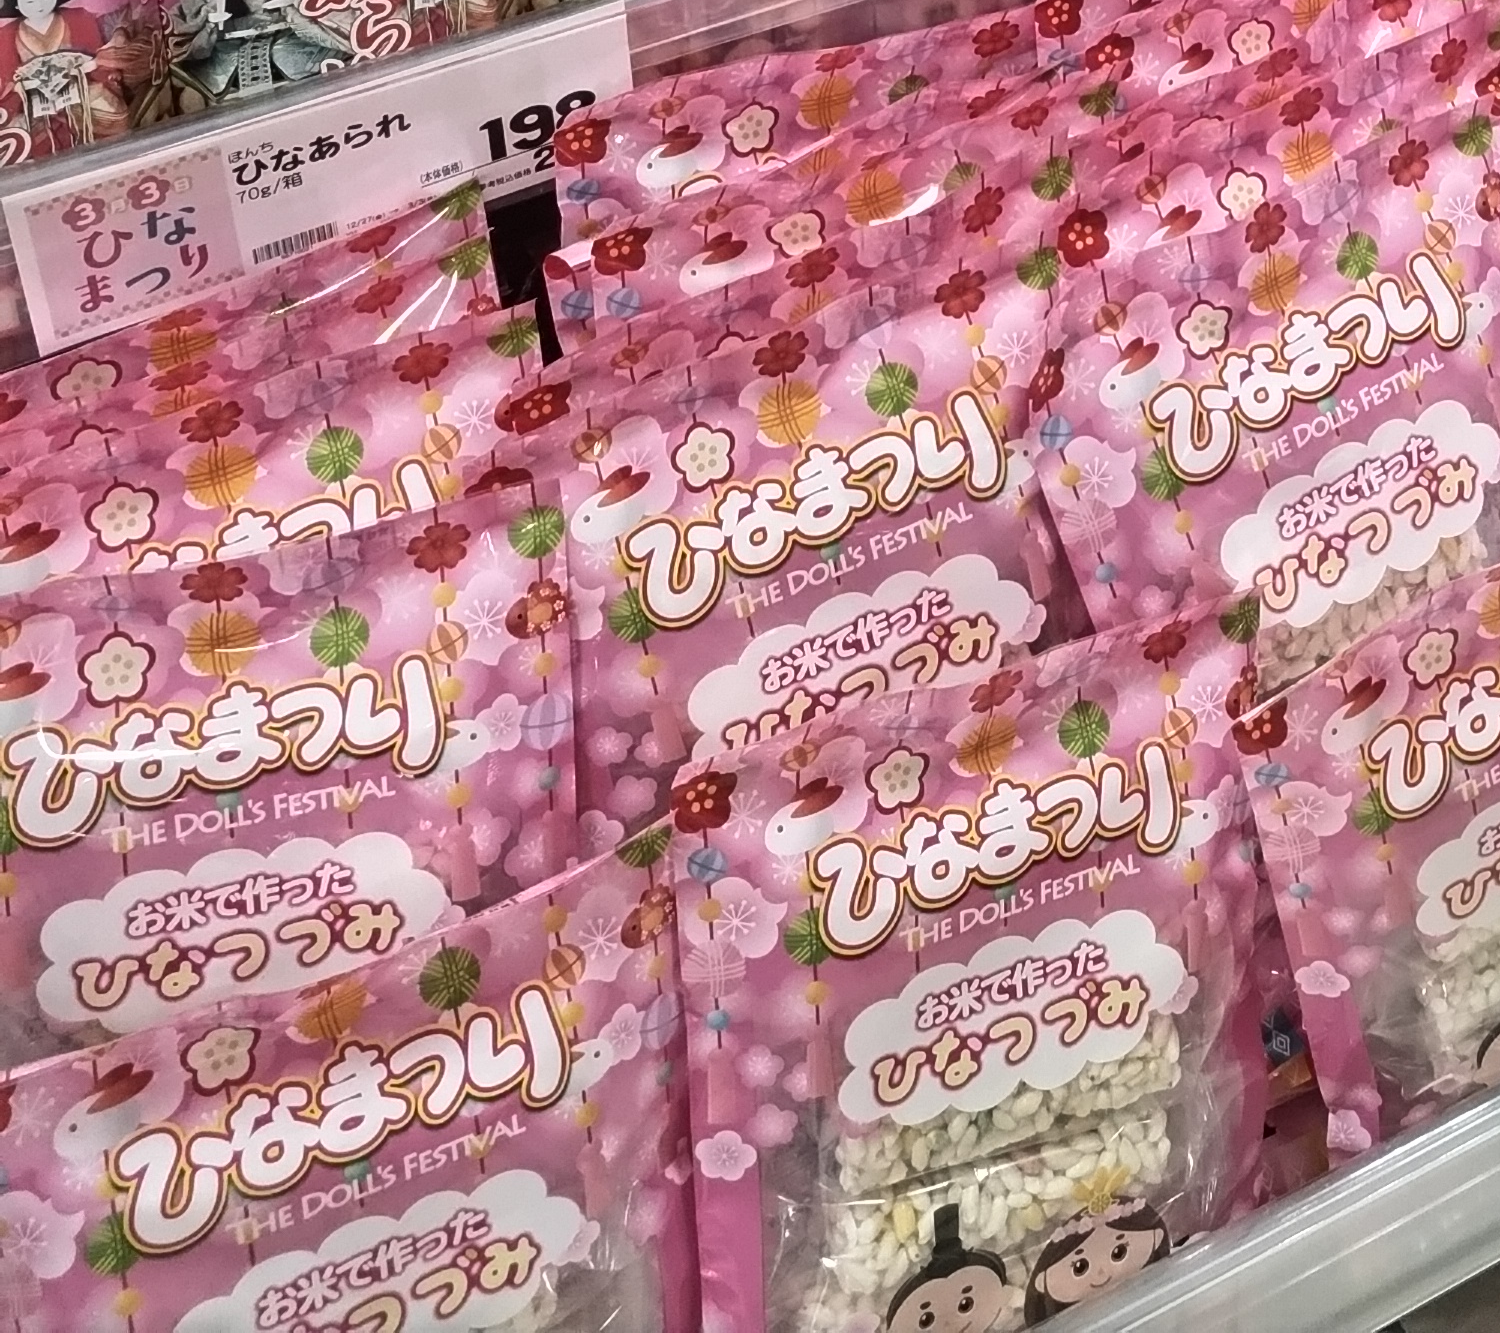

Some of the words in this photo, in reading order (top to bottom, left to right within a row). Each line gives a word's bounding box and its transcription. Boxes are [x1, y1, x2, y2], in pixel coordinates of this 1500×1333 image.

[233, 113, 411, 186] ひなあられ
[235, 172, 303, 204] 70g/箱
[77, 206, 198, 270] ひな
[79, 242, 210, 315] まつり
[1149, 251, 1467, 484] ひなまつり
[1240, 434, 1292, 475] THE
[1360, 351, 1445, 417] FESTIVAL
[626, 385, 1010, 629] ひなまつり
[1256, 456, 1477, 613] ひなつづみ
[1277, 436, 1439, 540] お米で作った
[725, 581, 782, 617] THE
[870, 501, 974, 564] FESTIVAL
[761, 585, 954, 693] お米で作った
[5, 653, 445, 847] ひなまつり
[100, 817, 168, 854] THE
[272, 775, 396, 819] FESTIVAL
[811, 738, 1182, 959] ひなまつり
[126, 861, 355, 937] お米で作った
[899, 916, 952, 953] THE
[1038, 854, 1141, 906] FESTIVAL
[74, 901, 400, 1010] ひなつづみ
[915, 943, 1107, 1029] お米で作った
[871, 976, 1150, 1104] ひなつづみ
[115, 979, 573, 1254] ひなまつり
[224, 1207, 295, 1245] THE
[402, 1114, 525, 1185] FESTIVAL
[256, 1205, 492, 1329] お米で作った
